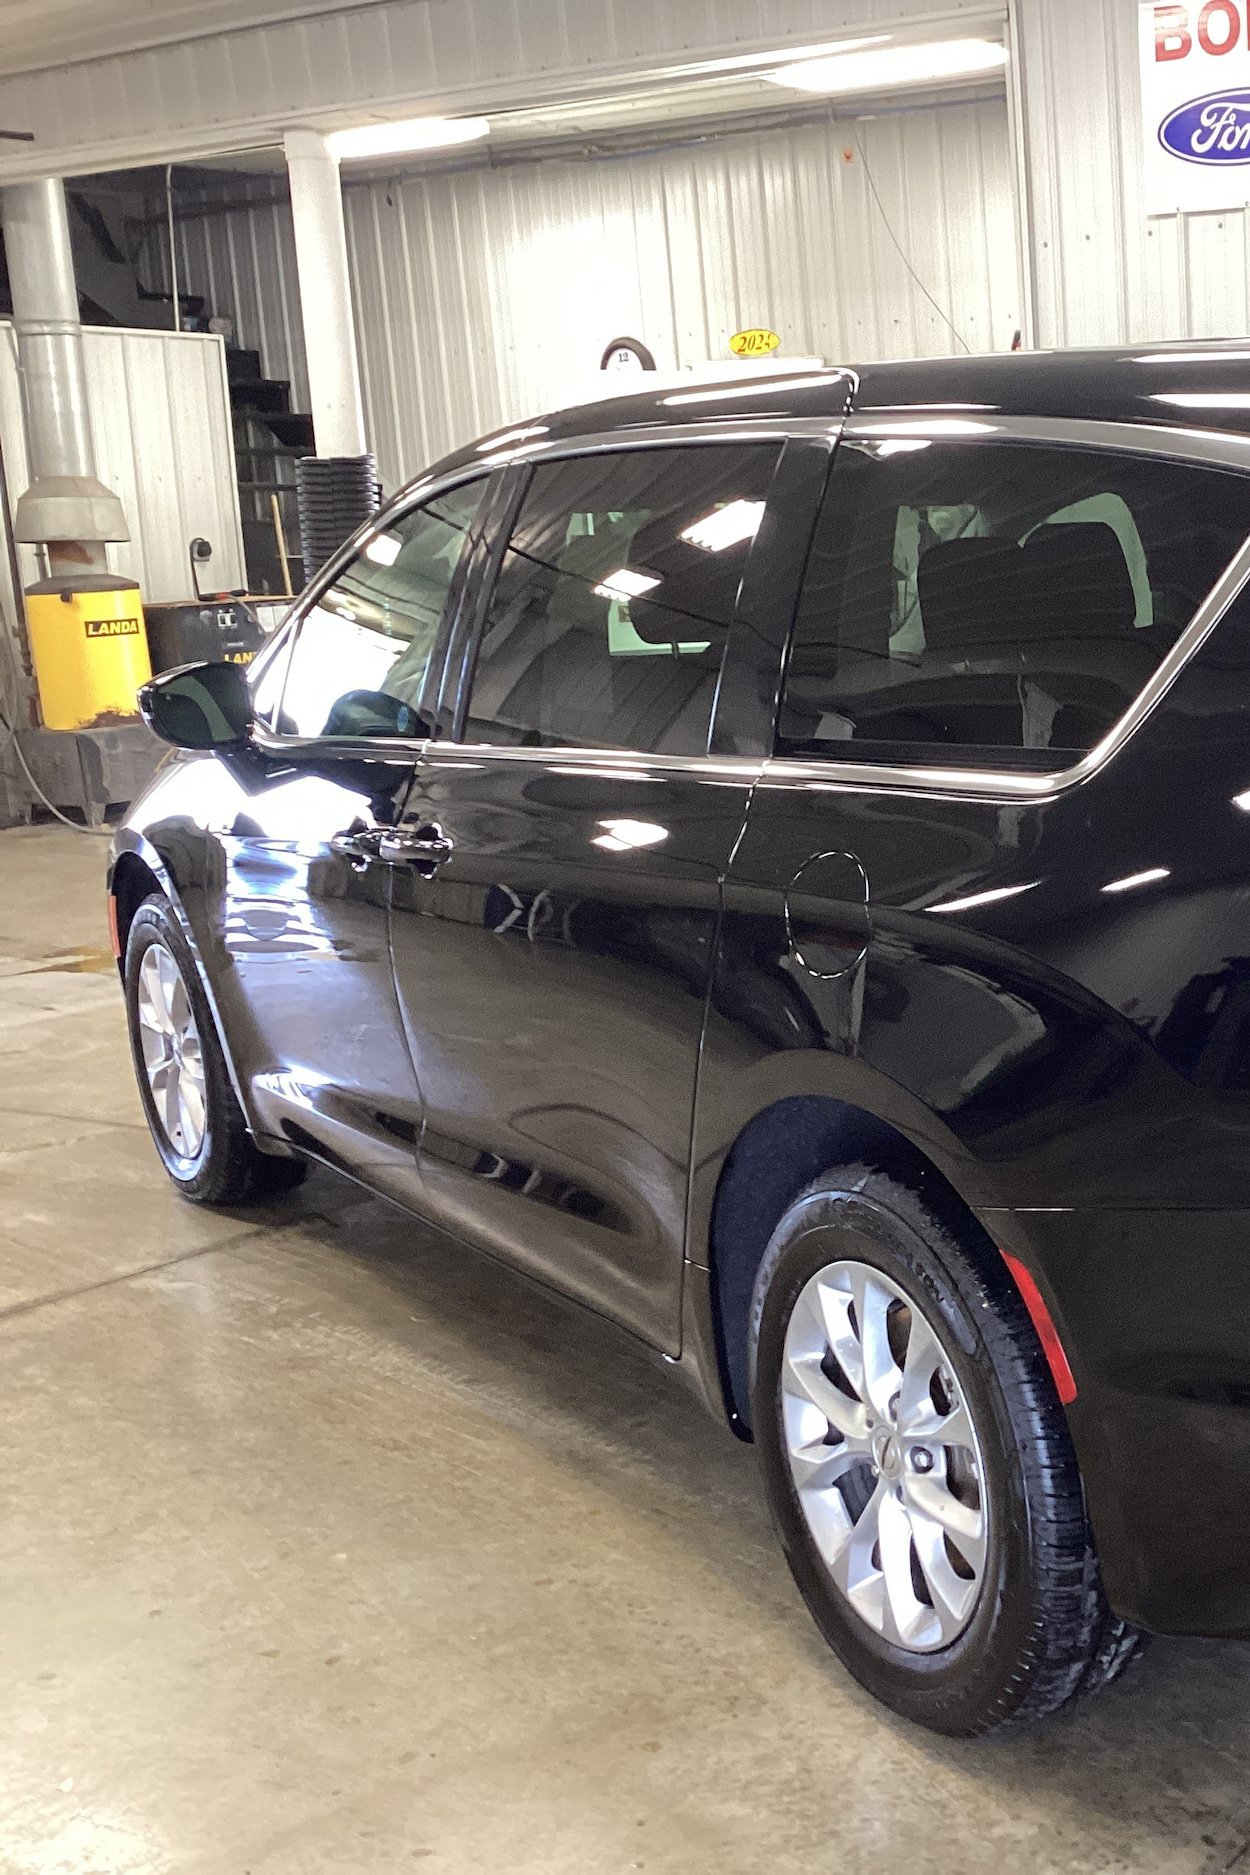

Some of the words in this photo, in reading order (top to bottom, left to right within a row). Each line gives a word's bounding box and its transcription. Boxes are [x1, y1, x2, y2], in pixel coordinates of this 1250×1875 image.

[738, 333, 771, 352] 2024
[618, 352, 629, 362] 12
[87, 620, 139, 637] LANDA
